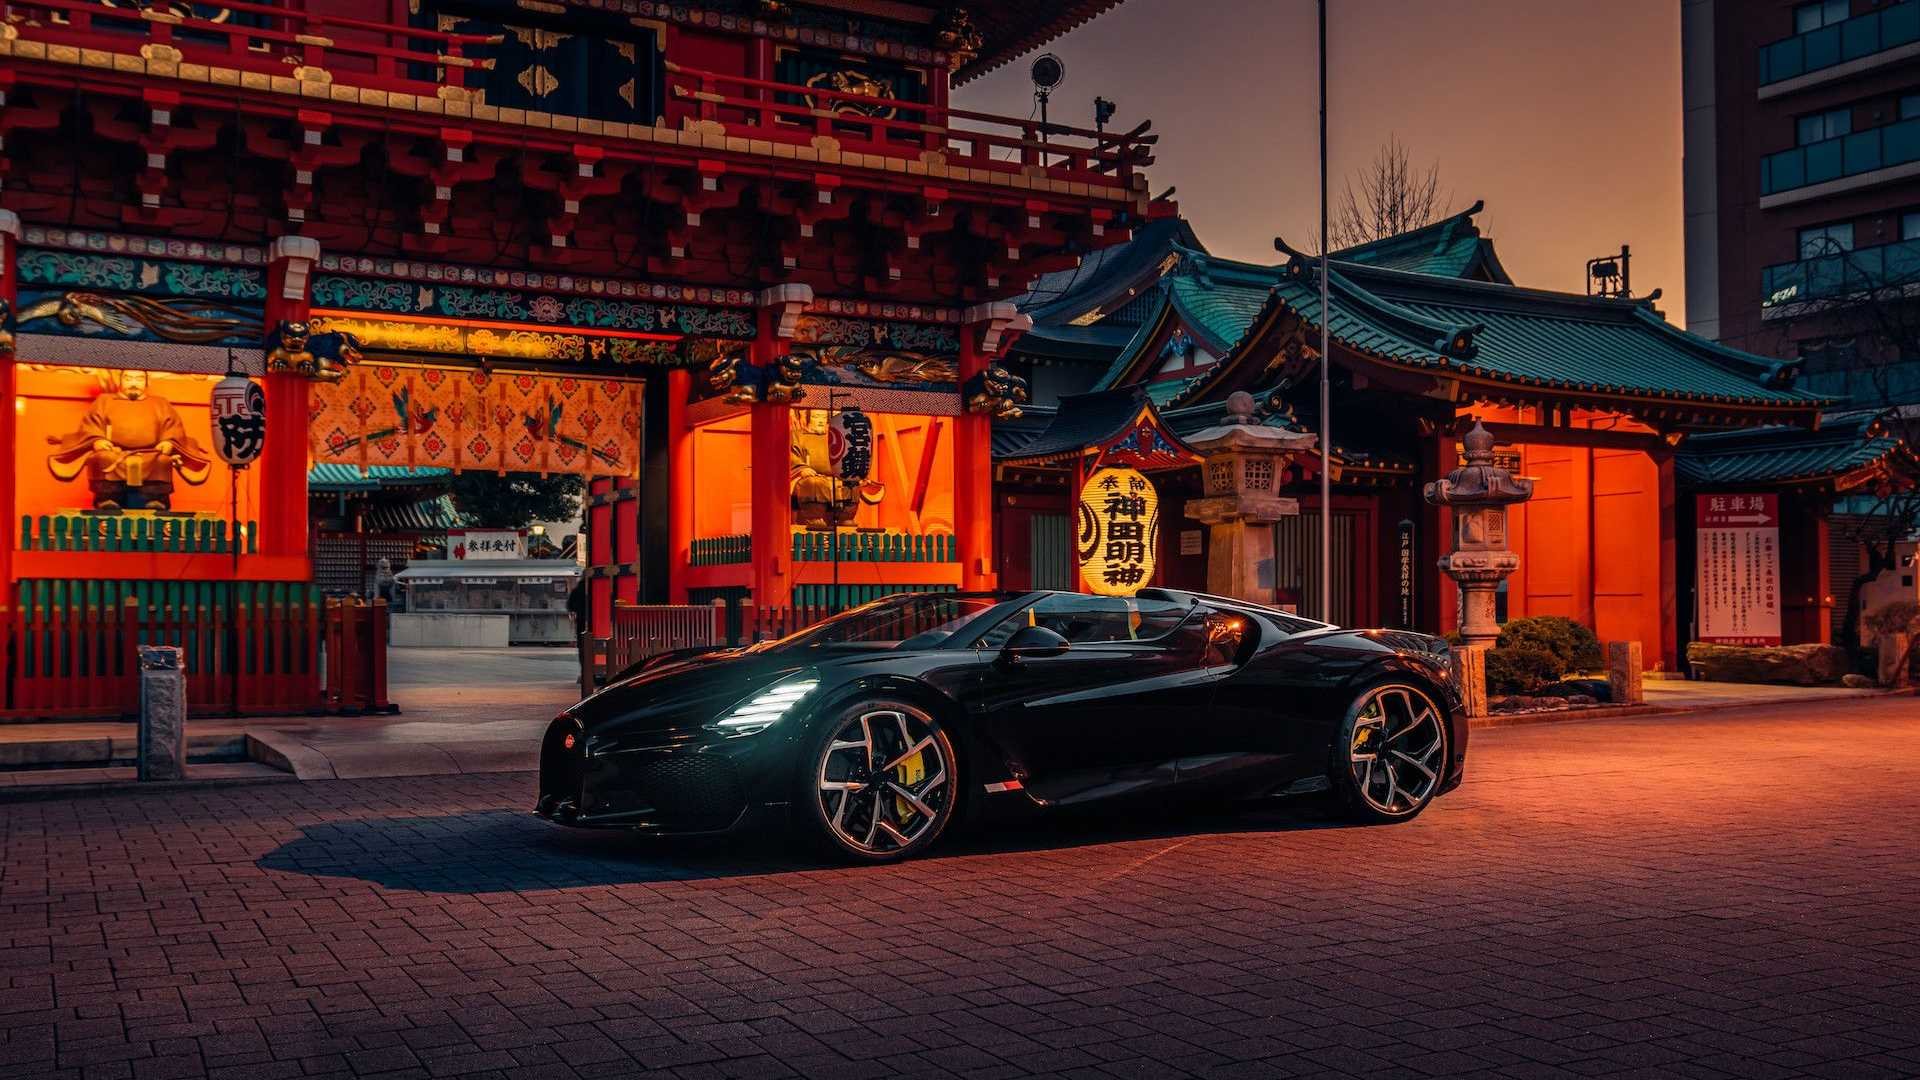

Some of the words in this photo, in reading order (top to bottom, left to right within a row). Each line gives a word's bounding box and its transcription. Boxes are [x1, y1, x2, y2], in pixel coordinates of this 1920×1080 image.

[1710, 496, 1766, 512] 駐車場
[469, 539, 516, 552] 参拝受付
[1103, 492, 1147, 586] 神田明神
